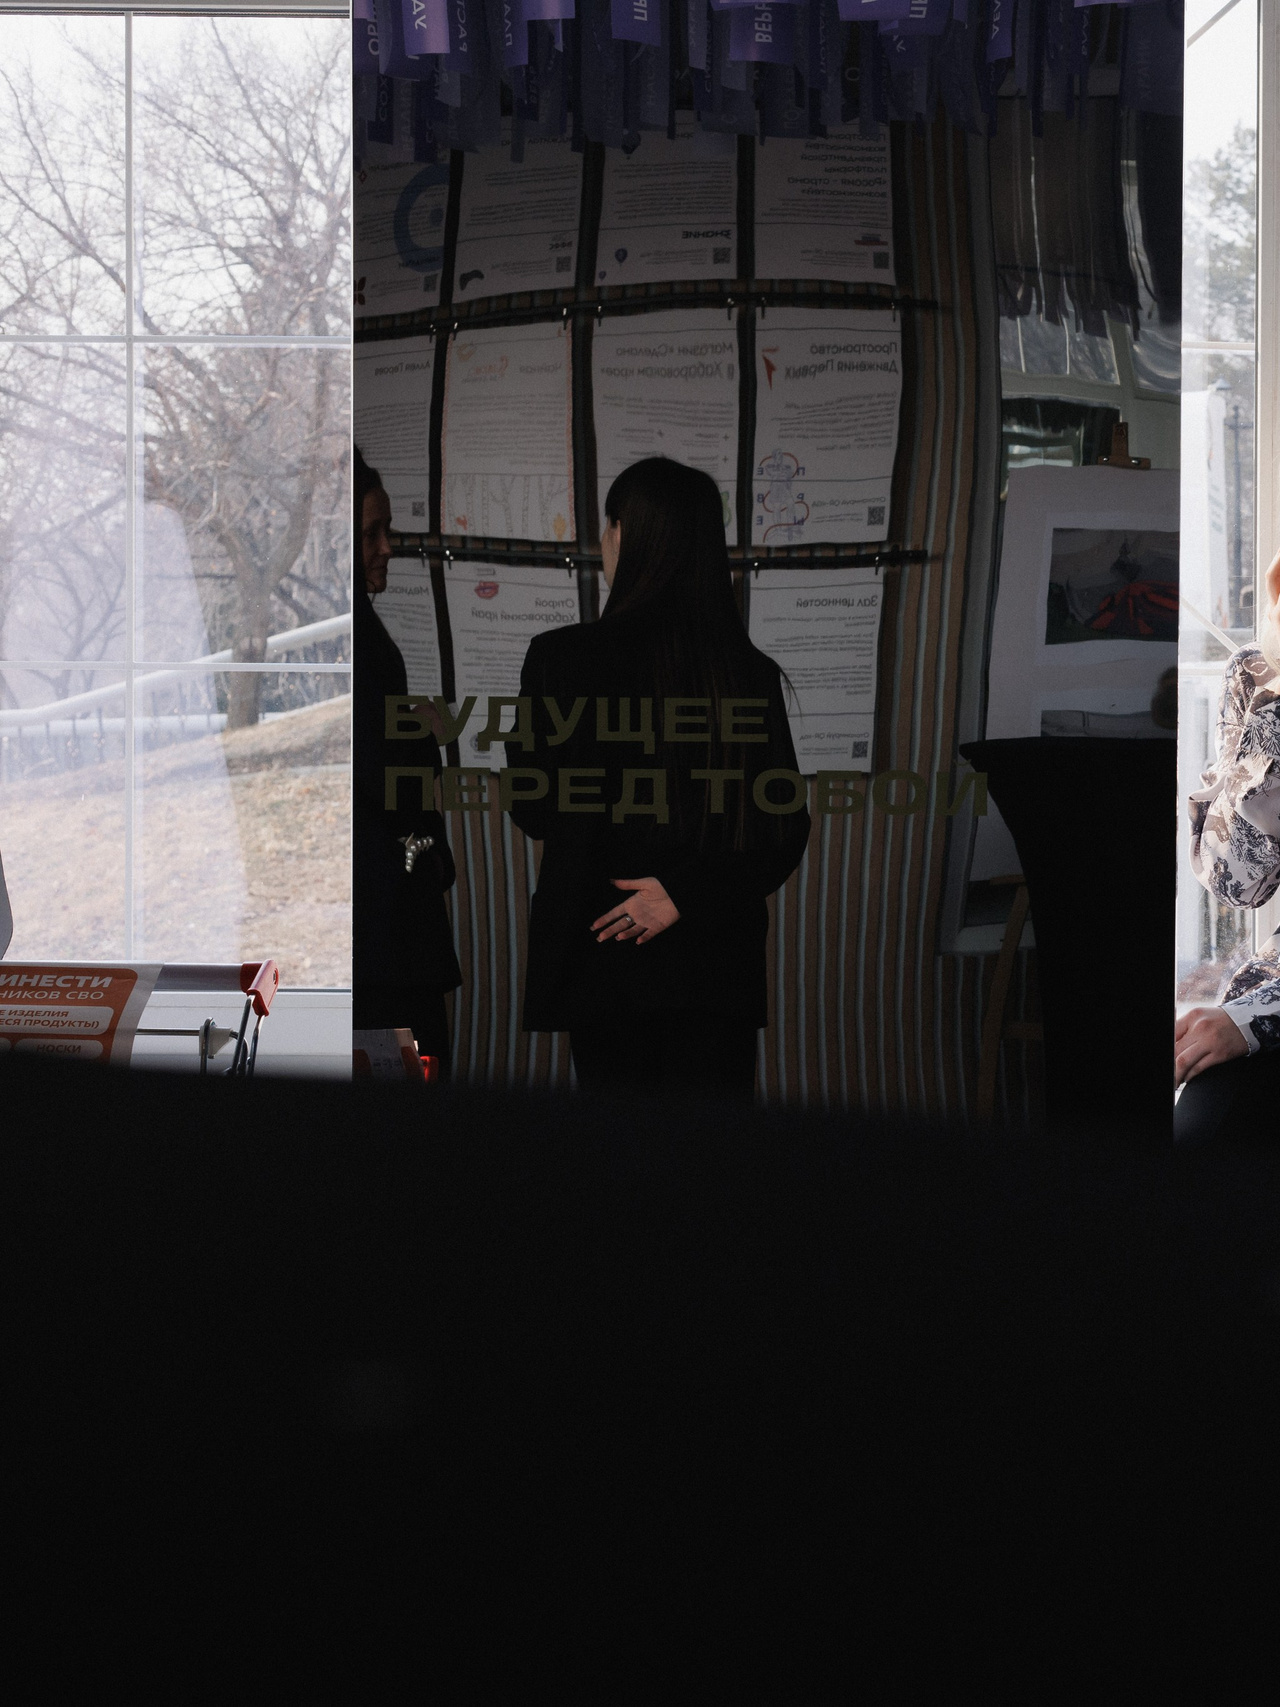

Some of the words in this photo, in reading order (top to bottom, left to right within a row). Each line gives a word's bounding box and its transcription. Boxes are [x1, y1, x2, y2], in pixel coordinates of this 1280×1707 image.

[384, 695, 769, 755] БУДУЩЕЕ
[384, 766, 671, 824] ПЕРЕД
[66, 991, 104, 1000] СВО
[8, 1010, 70, 1018] ИЗДЕЛИЯ
[24, 1019, 100, 1029] ПРОДУКТЫ)
[36, 1044, 82, 1053] НОСКИ
